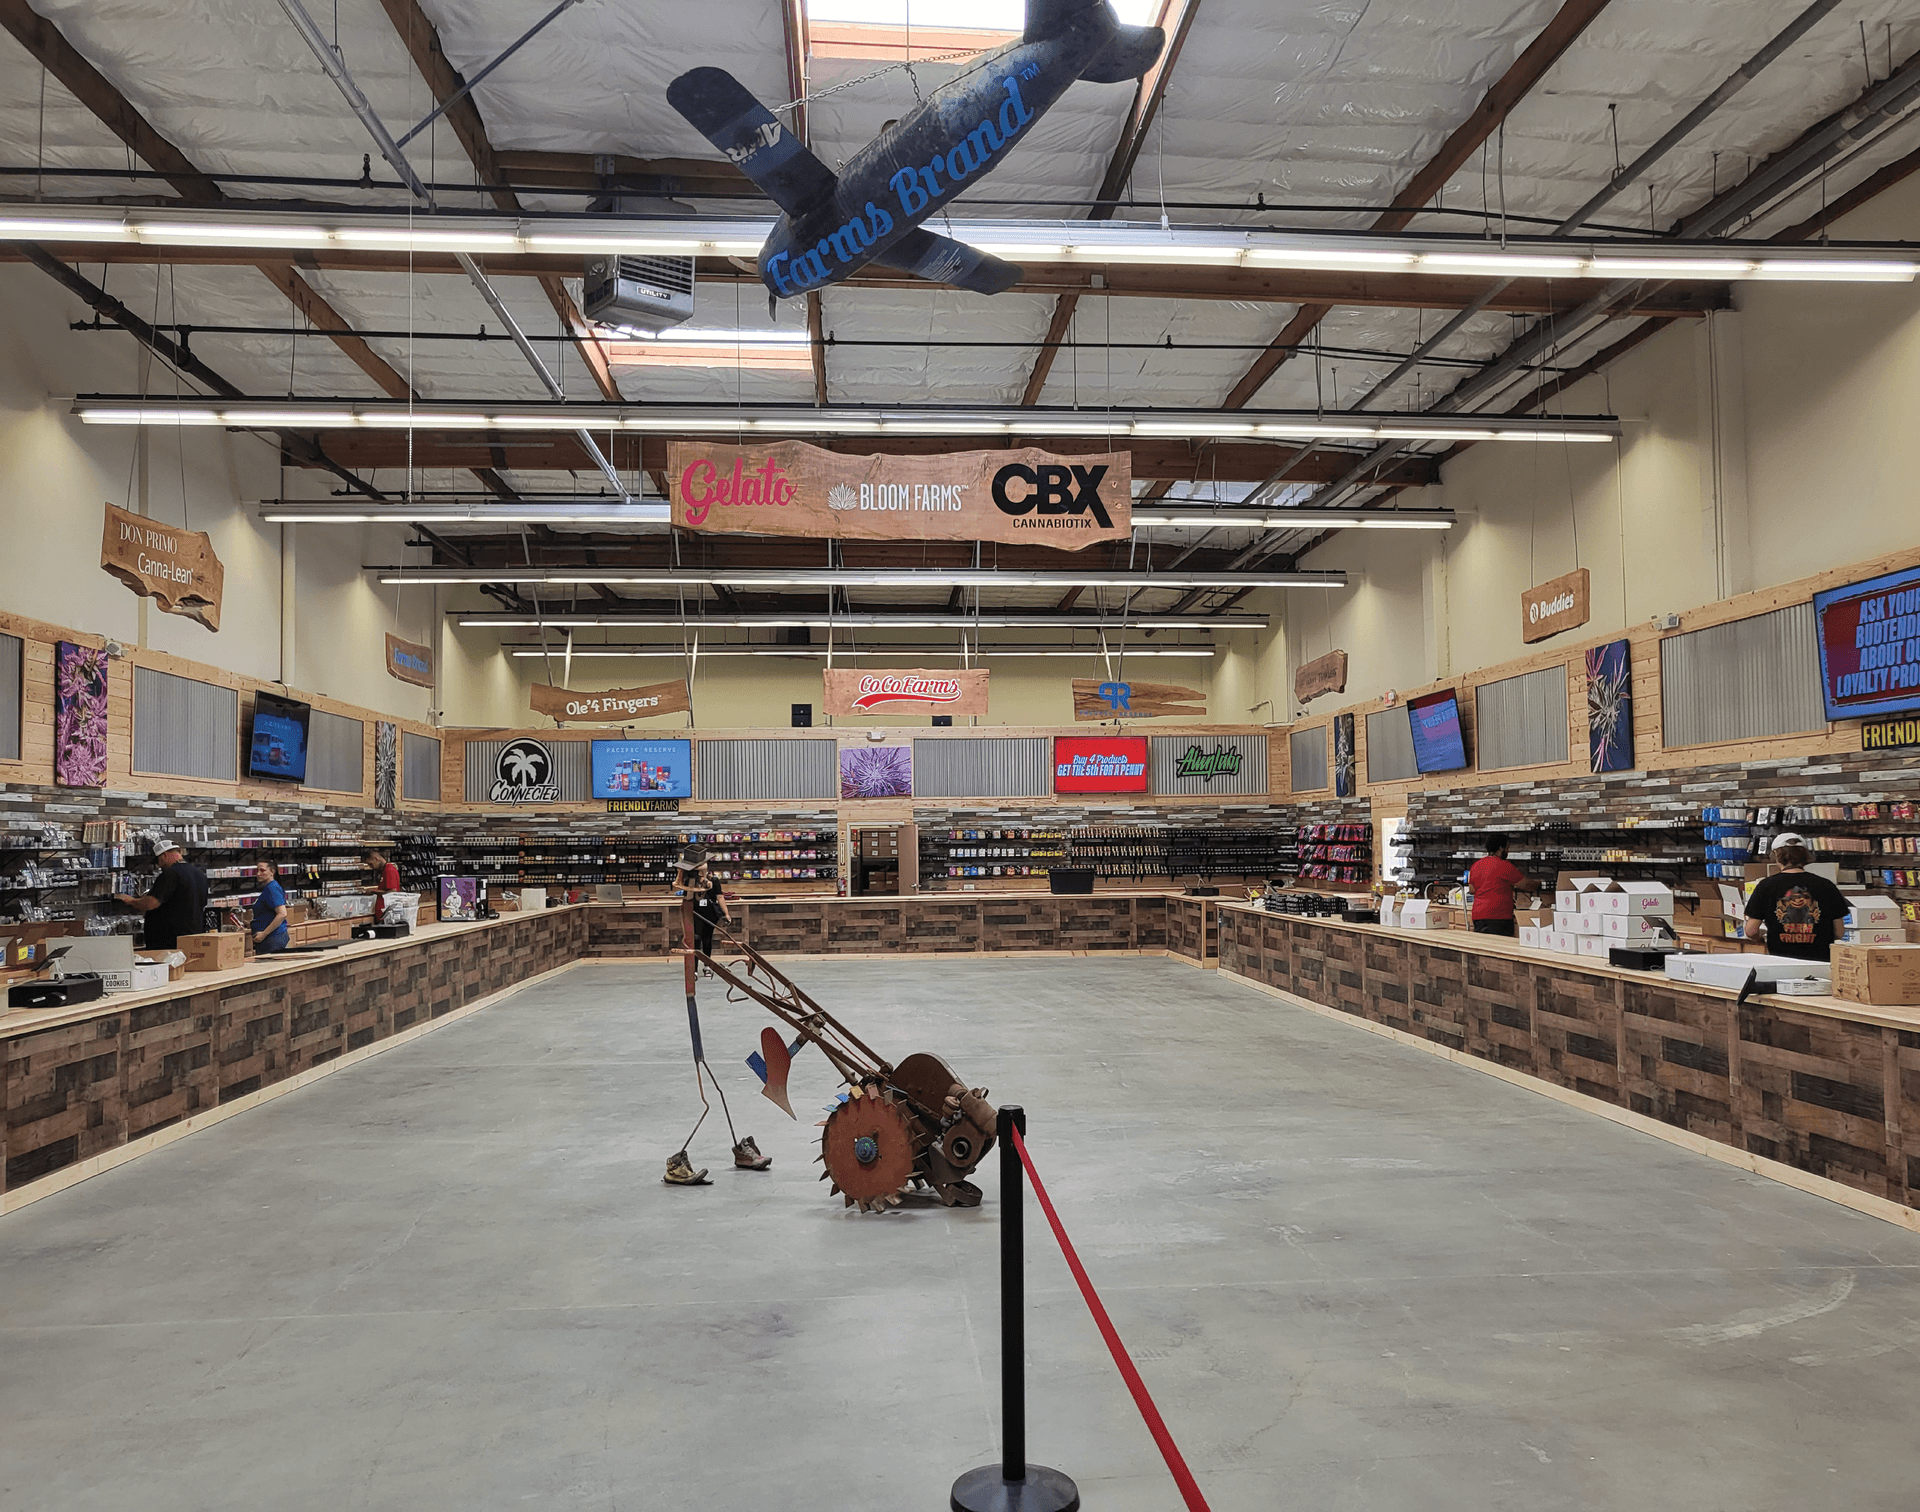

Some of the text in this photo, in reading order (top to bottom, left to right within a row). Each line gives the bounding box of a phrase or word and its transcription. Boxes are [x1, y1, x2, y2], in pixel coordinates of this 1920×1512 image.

[766, 201, 894, 295] Farms
[889, 76, 1034, 217] Brand
[640, 288, 668, 298] UTILITY
[681, 456, 798, 525] Gelato
[860, 483, 910, 511] BLOOM
[914, 484, 962, 511] FARMS
[991, 463, 1115, 528] CBX
[1013, 519, 1092, 529] CANNABIOTIX
[120, 522, 178, 555] DON PRIMO
[138, 552, 193, 585] Canna-Lean
[1540, 592, 1574, 620] Buddies
[1859, 596, 1886, 624] ASK
[1859, 641, 1904, 671] ABOUT
[1836, 668, 1889, 698] LOYALTY
[601, 696, 659, 714] Fingers
[1057, 764, 1071, 776] GET
[1072, 764, 1085, 776] THE
[1099, 764, 1114, 776] FOR
[1114, 764, 1121, 776] A
[1120, 764, 1145, 776] PENNY
[1073, 753, 1128, 766] Buy 4 Products
[489, 780, 560, 806] CONNECTED
[105, 979, 129, 987] COOKIES
